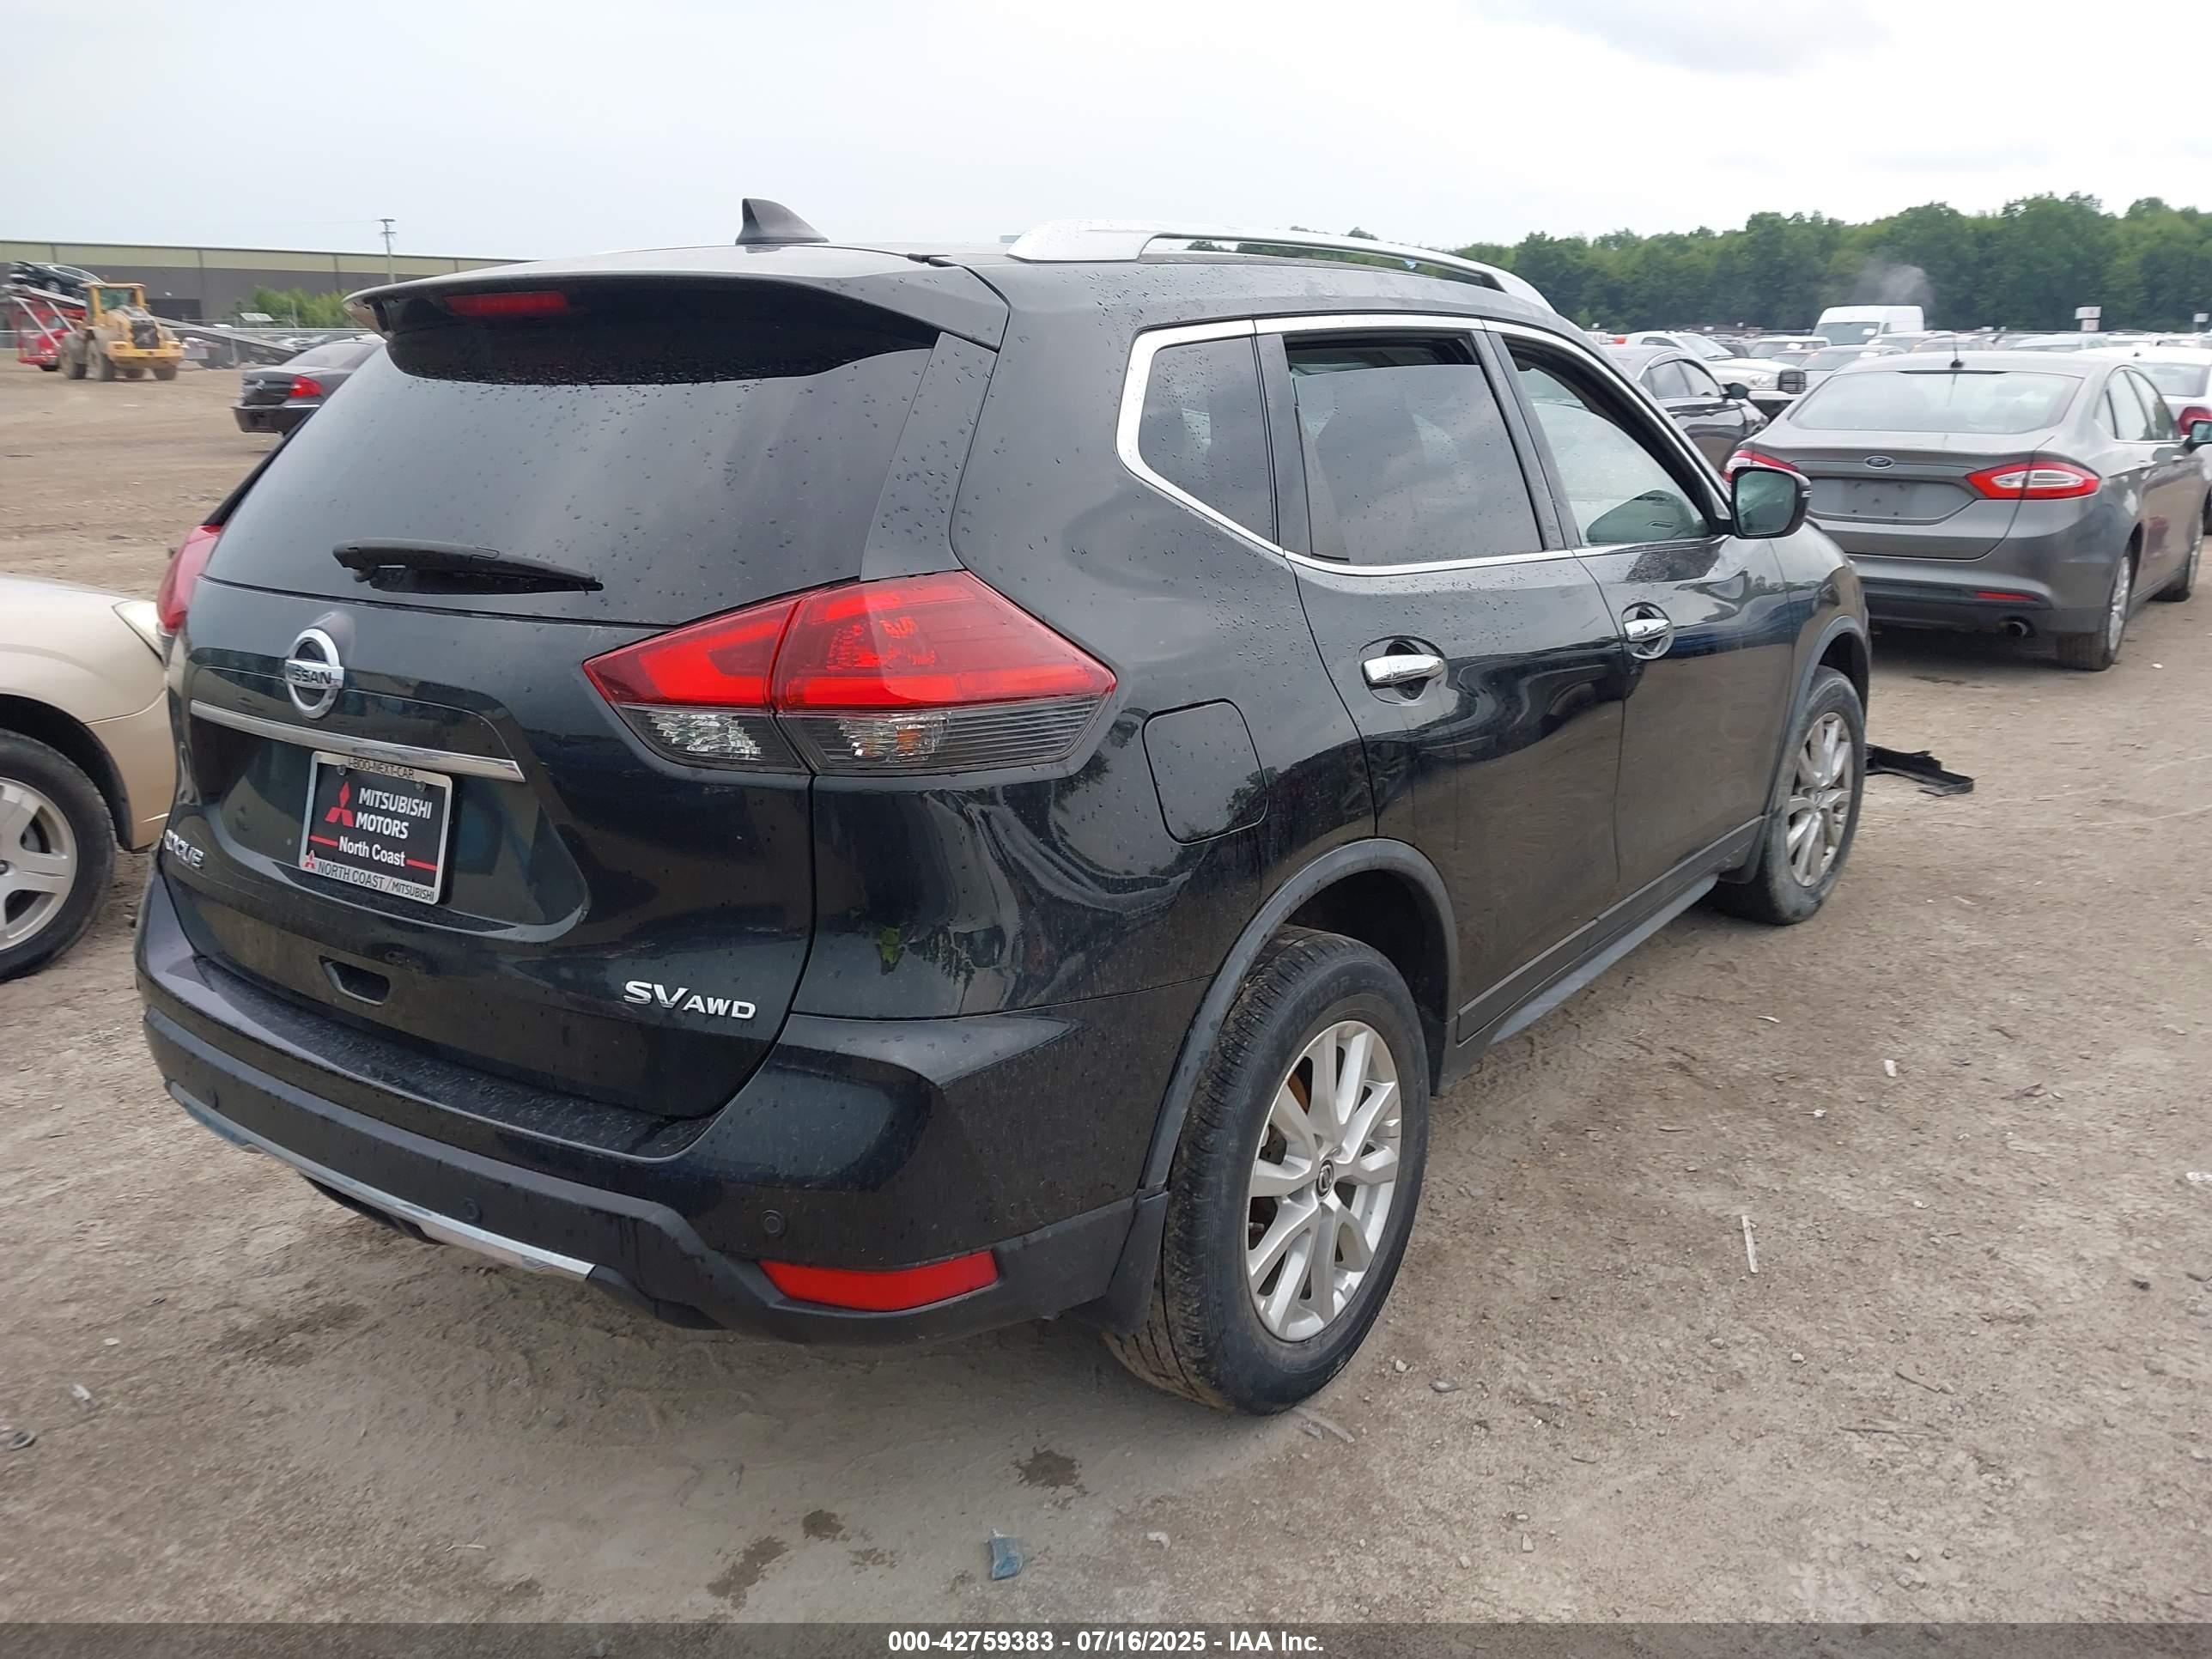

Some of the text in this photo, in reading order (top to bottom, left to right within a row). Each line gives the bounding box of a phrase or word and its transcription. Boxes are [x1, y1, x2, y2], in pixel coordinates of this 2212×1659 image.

[358, 787, 433, 819] MITSUBISHI
[356, 811, 410, 839] MOTORS
[338, 836, 405, 866] North Coast
[318, 860, 350, 881] NORTH
[352, 870, 386, 890] COAST
[392, 882, 434, 902] MITSUBISHI
[623, 981, 757, 1019] SV AWD
